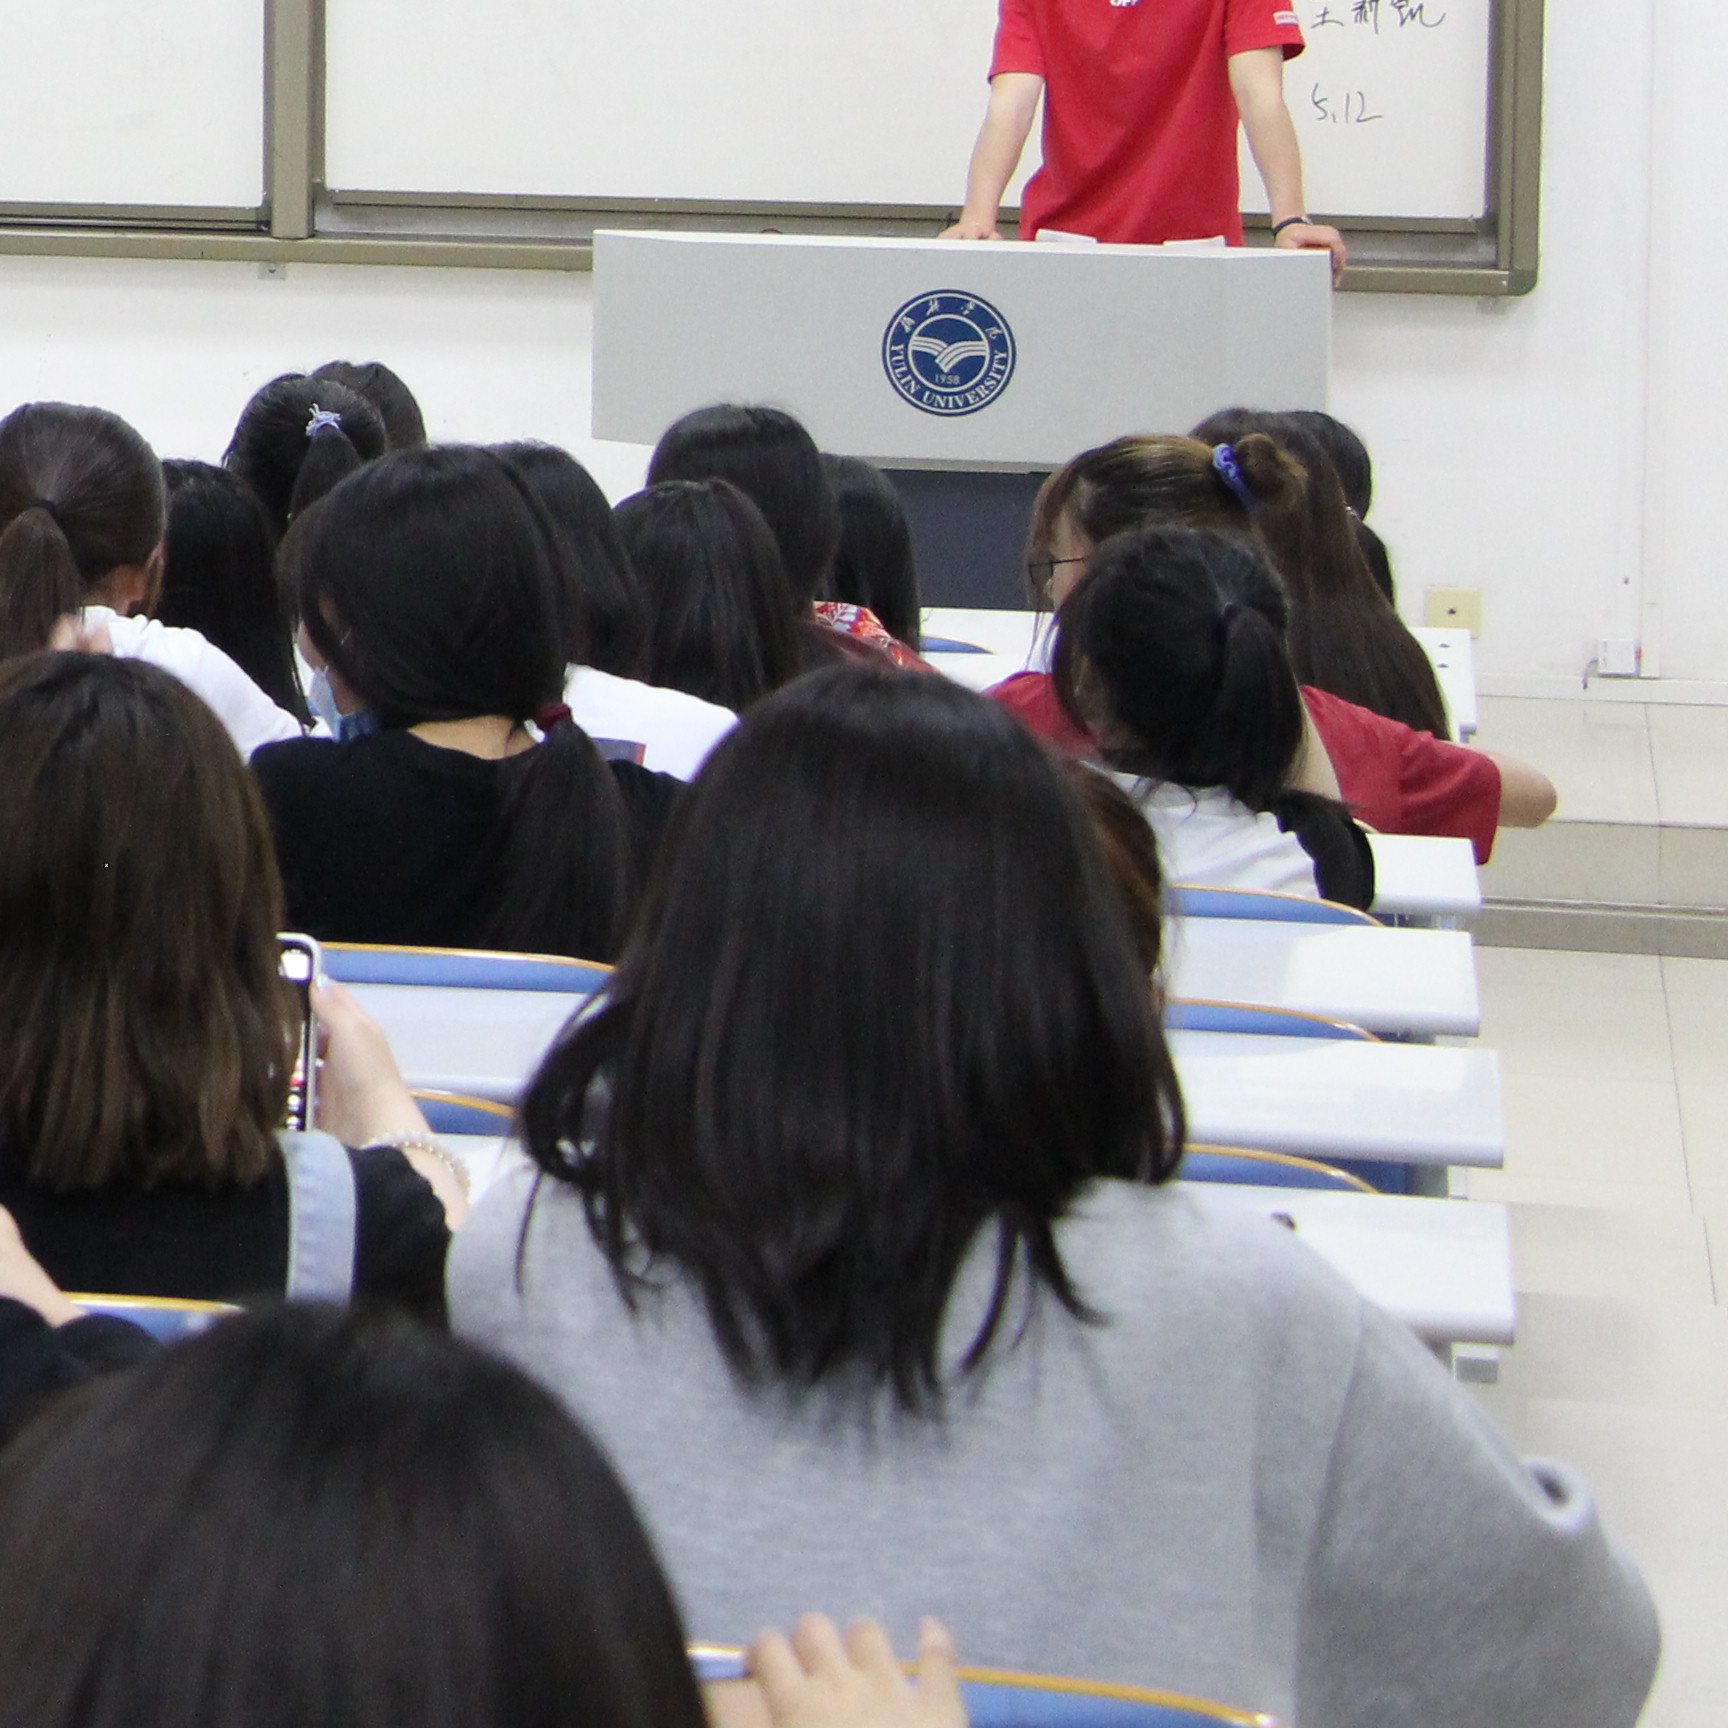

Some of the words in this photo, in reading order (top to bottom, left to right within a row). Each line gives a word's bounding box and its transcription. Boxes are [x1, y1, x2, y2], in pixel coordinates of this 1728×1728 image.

[1311, 82, 1384, 125] 5.12
[890, 343, 921, 395] YULIN
[921, 349, 1008, 409] UNIVERSITY
[935, 373, 961, 385] 1958
